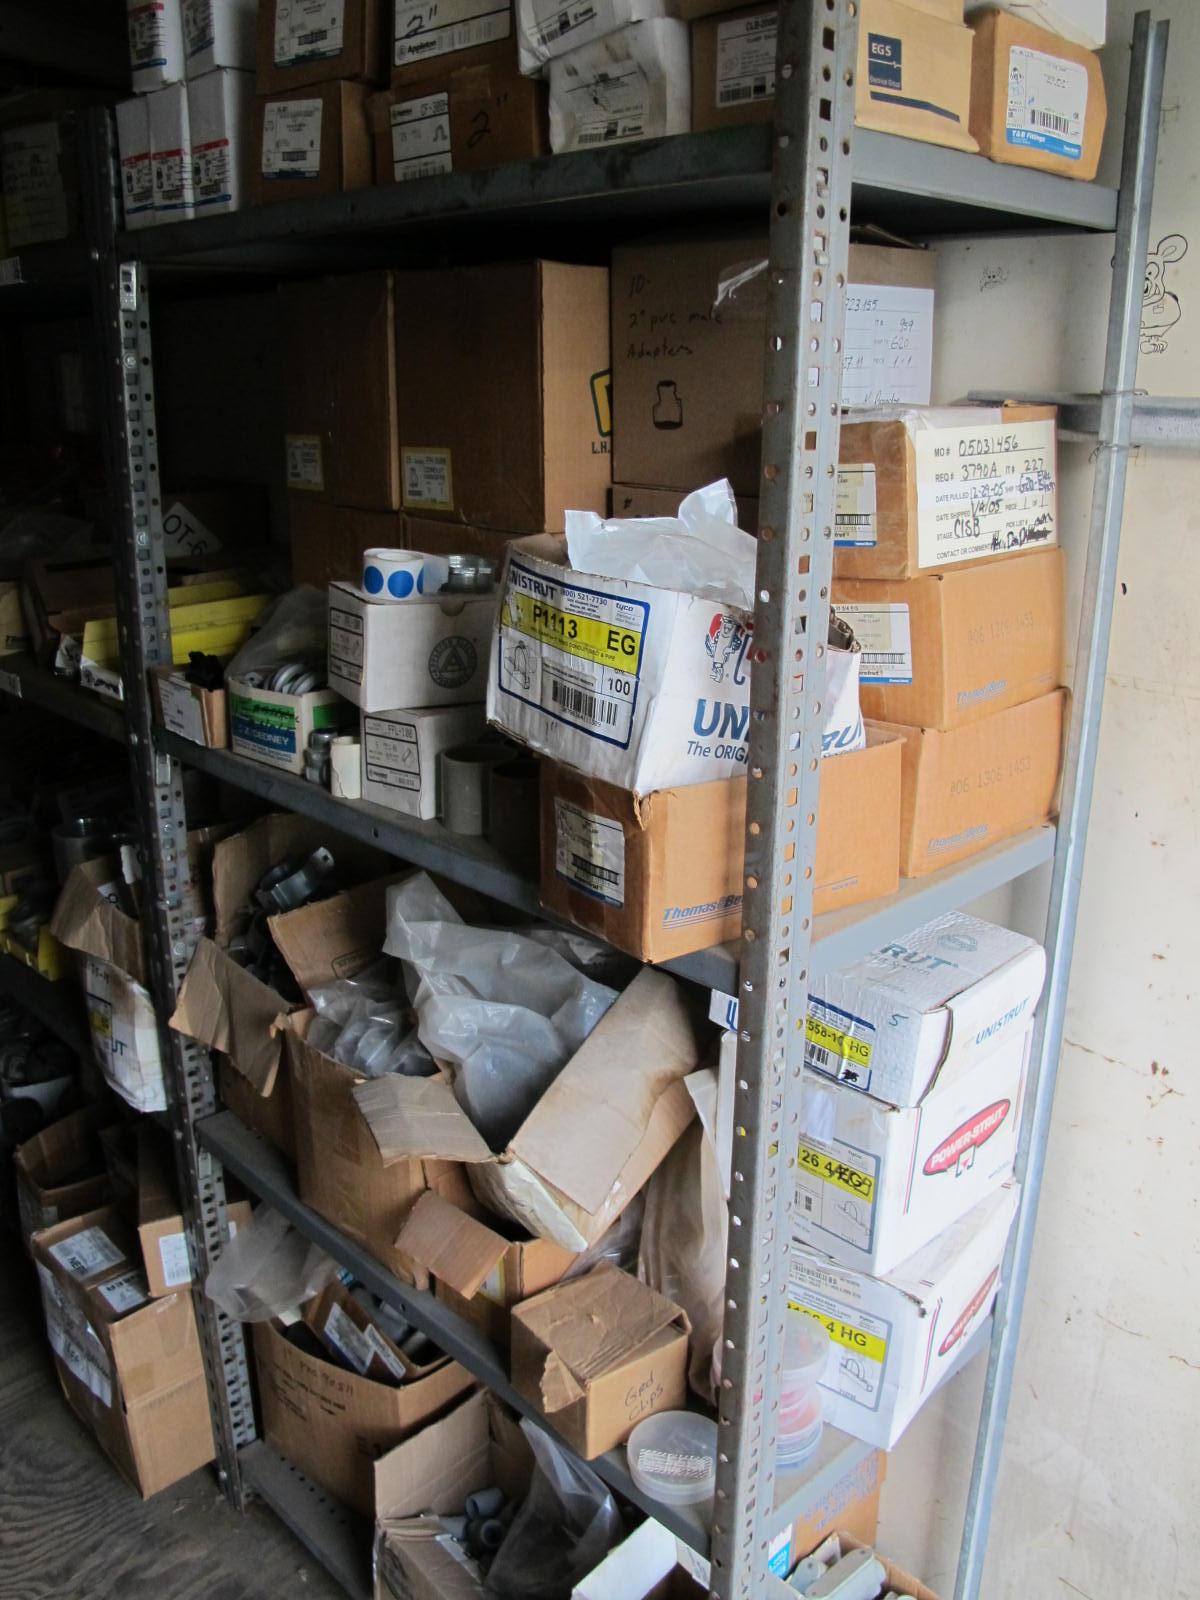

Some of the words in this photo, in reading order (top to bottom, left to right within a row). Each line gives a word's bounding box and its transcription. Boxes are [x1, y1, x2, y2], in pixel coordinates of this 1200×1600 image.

[408, 40, 437, 54] Appleton
[872, 42, 892, 57] EGS
[959, 434, 1018, 457] 05031456
[961, 461, 997, 481] 3790A
[1024, 458, 1044, 472] 227
[935, 495, 950, 503] DATE
[935, 513, 950, 522] DATE
[936, 532, 953, 541] STAGE
[936, 550, 960, 560] CONTACT
[510, 569, 558, 600] NISTRUT
[615, 602, 634, 612] tyco
[533, 605, 578, 639] P1113
[607, 629, 636, 656] EG
[608, 677, 631, 696] 100
[693, 698, 750, 742] UN
[687, 741, 711, 758] The
[975, 997, 1029, 1045] UNISTRUT
[849, 1040, 869, 1057] HG
[825, 1321, 835, 1334] 4
[840, 1326, 867, 1347] HG
